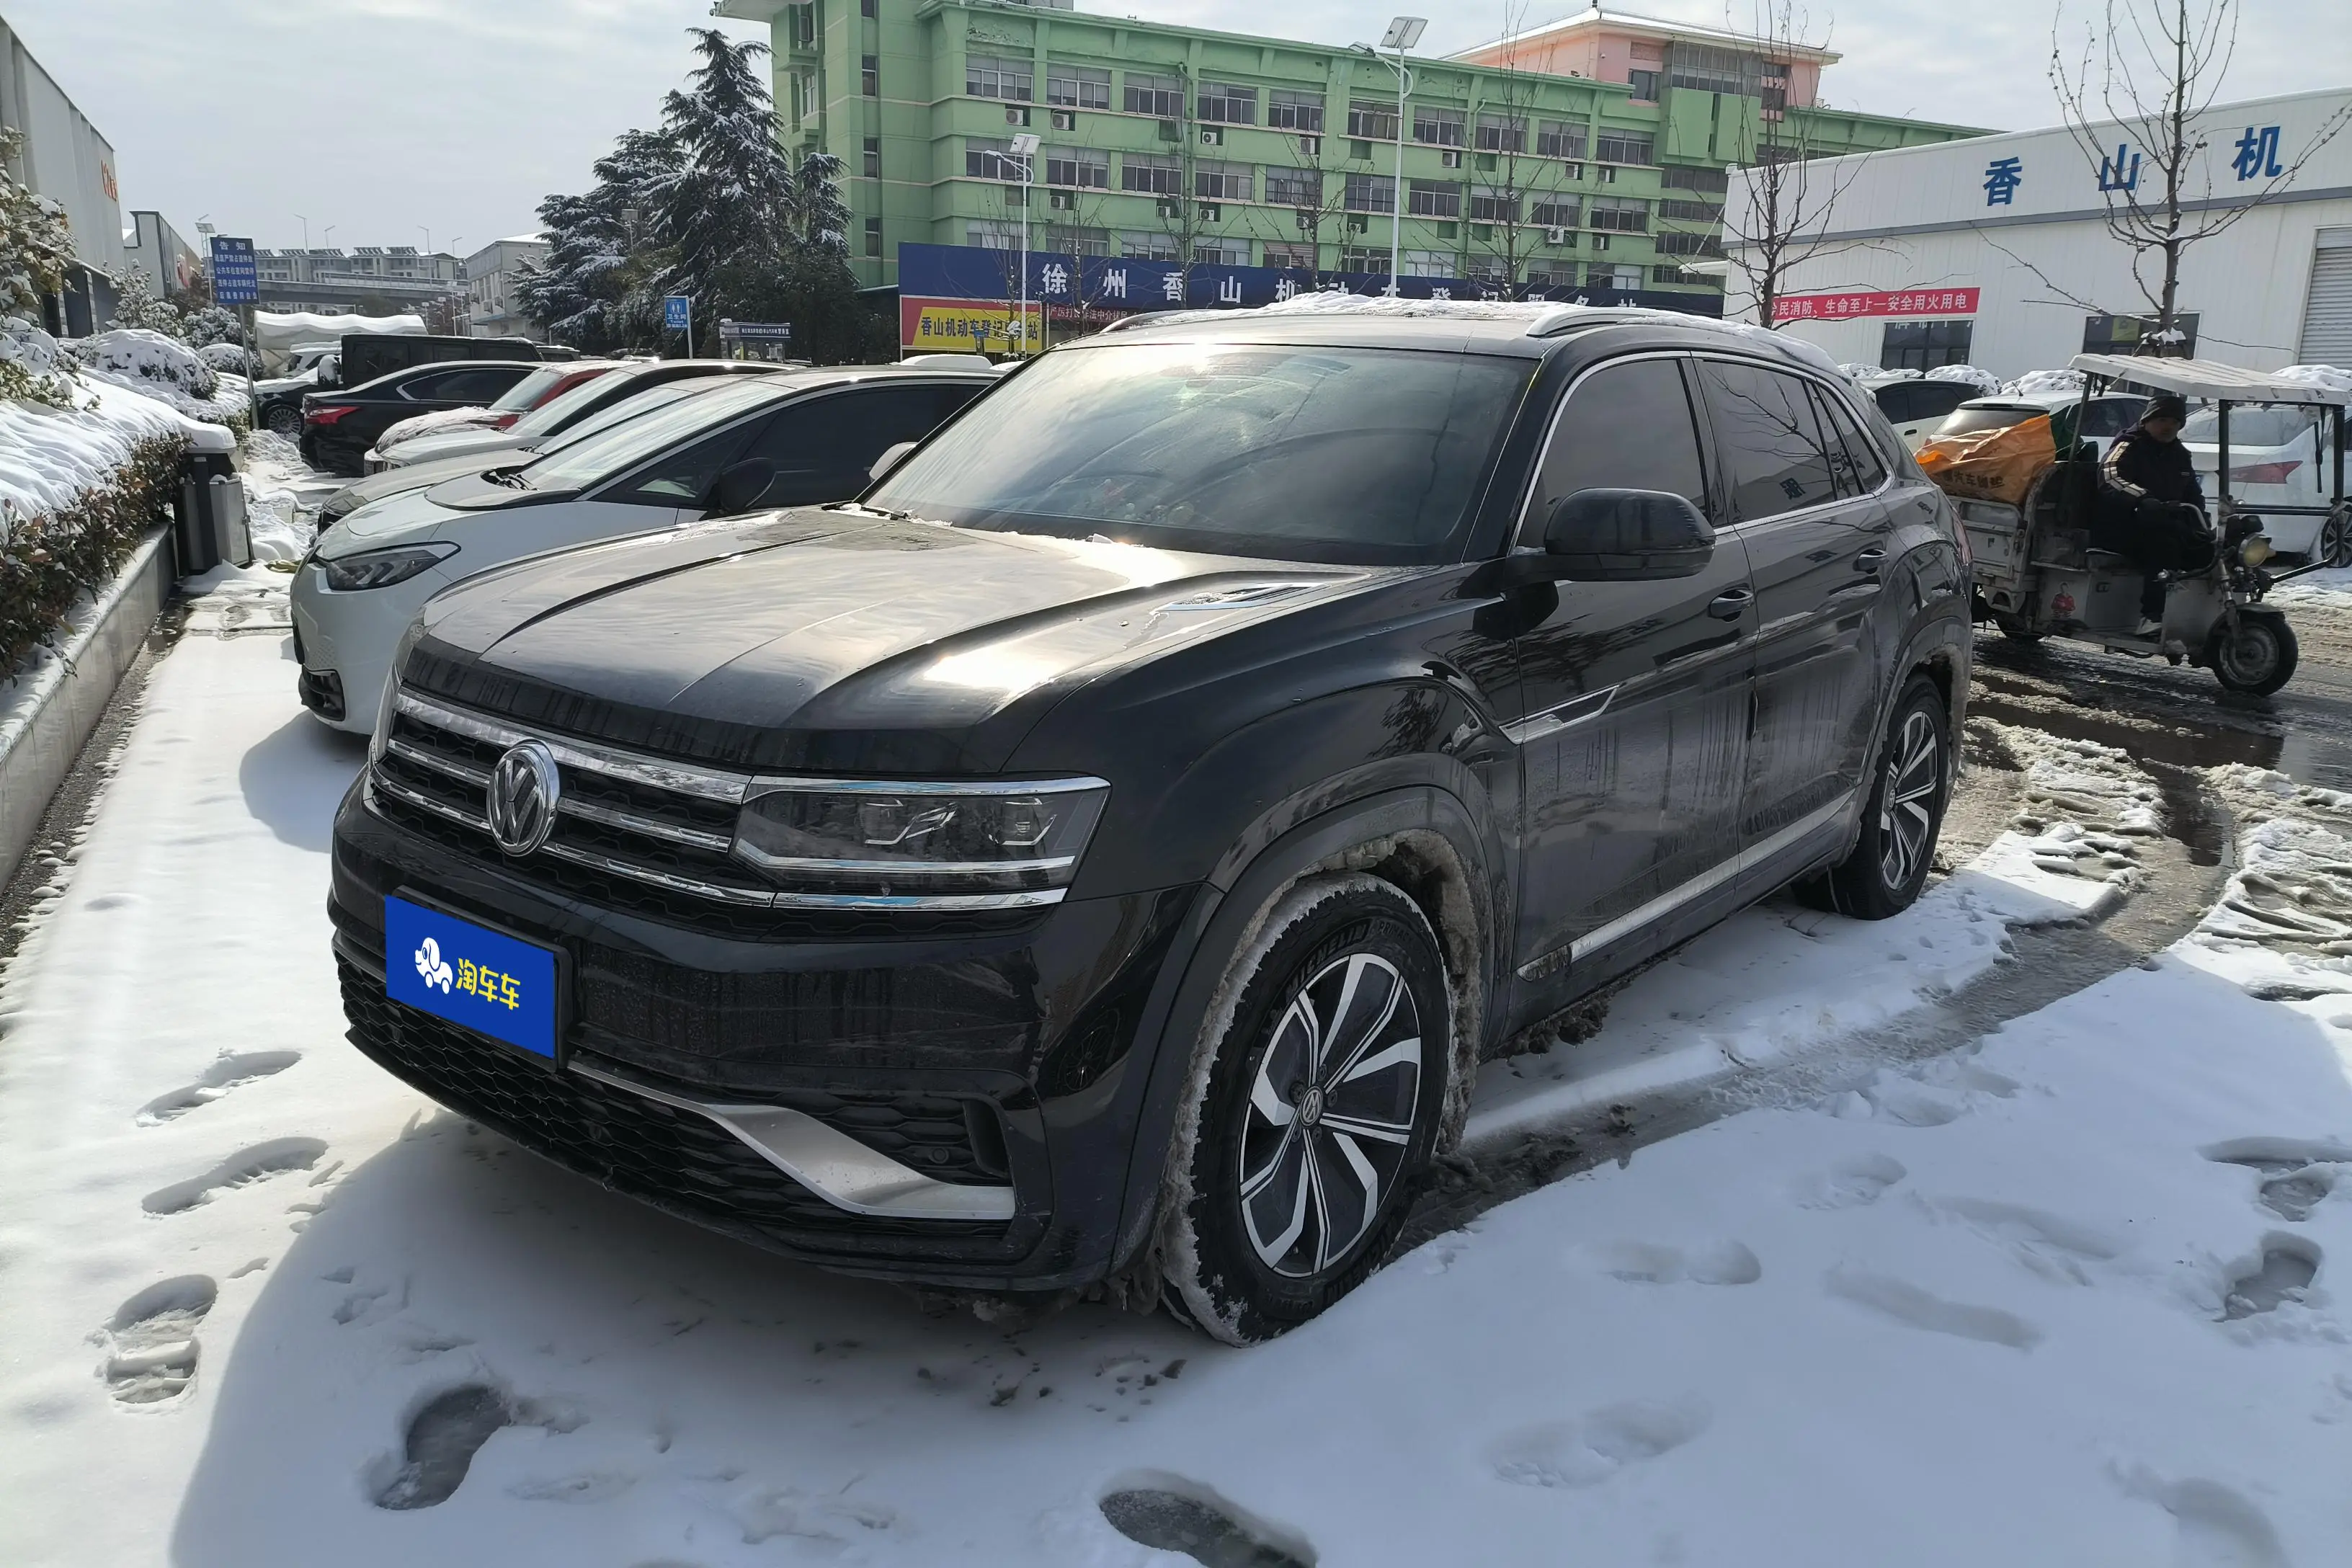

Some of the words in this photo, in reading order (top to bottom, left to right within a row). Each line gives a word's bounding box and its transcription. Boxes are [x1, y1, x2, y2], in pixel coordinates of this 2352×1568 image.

[1983, 126, 2283, 206] 香山机
[219, 241, 246, 250] 告知
[922, 316, 1038, 341] 香山机动车登记站
[1286, 923, 1368, 1004] MICHELIN
